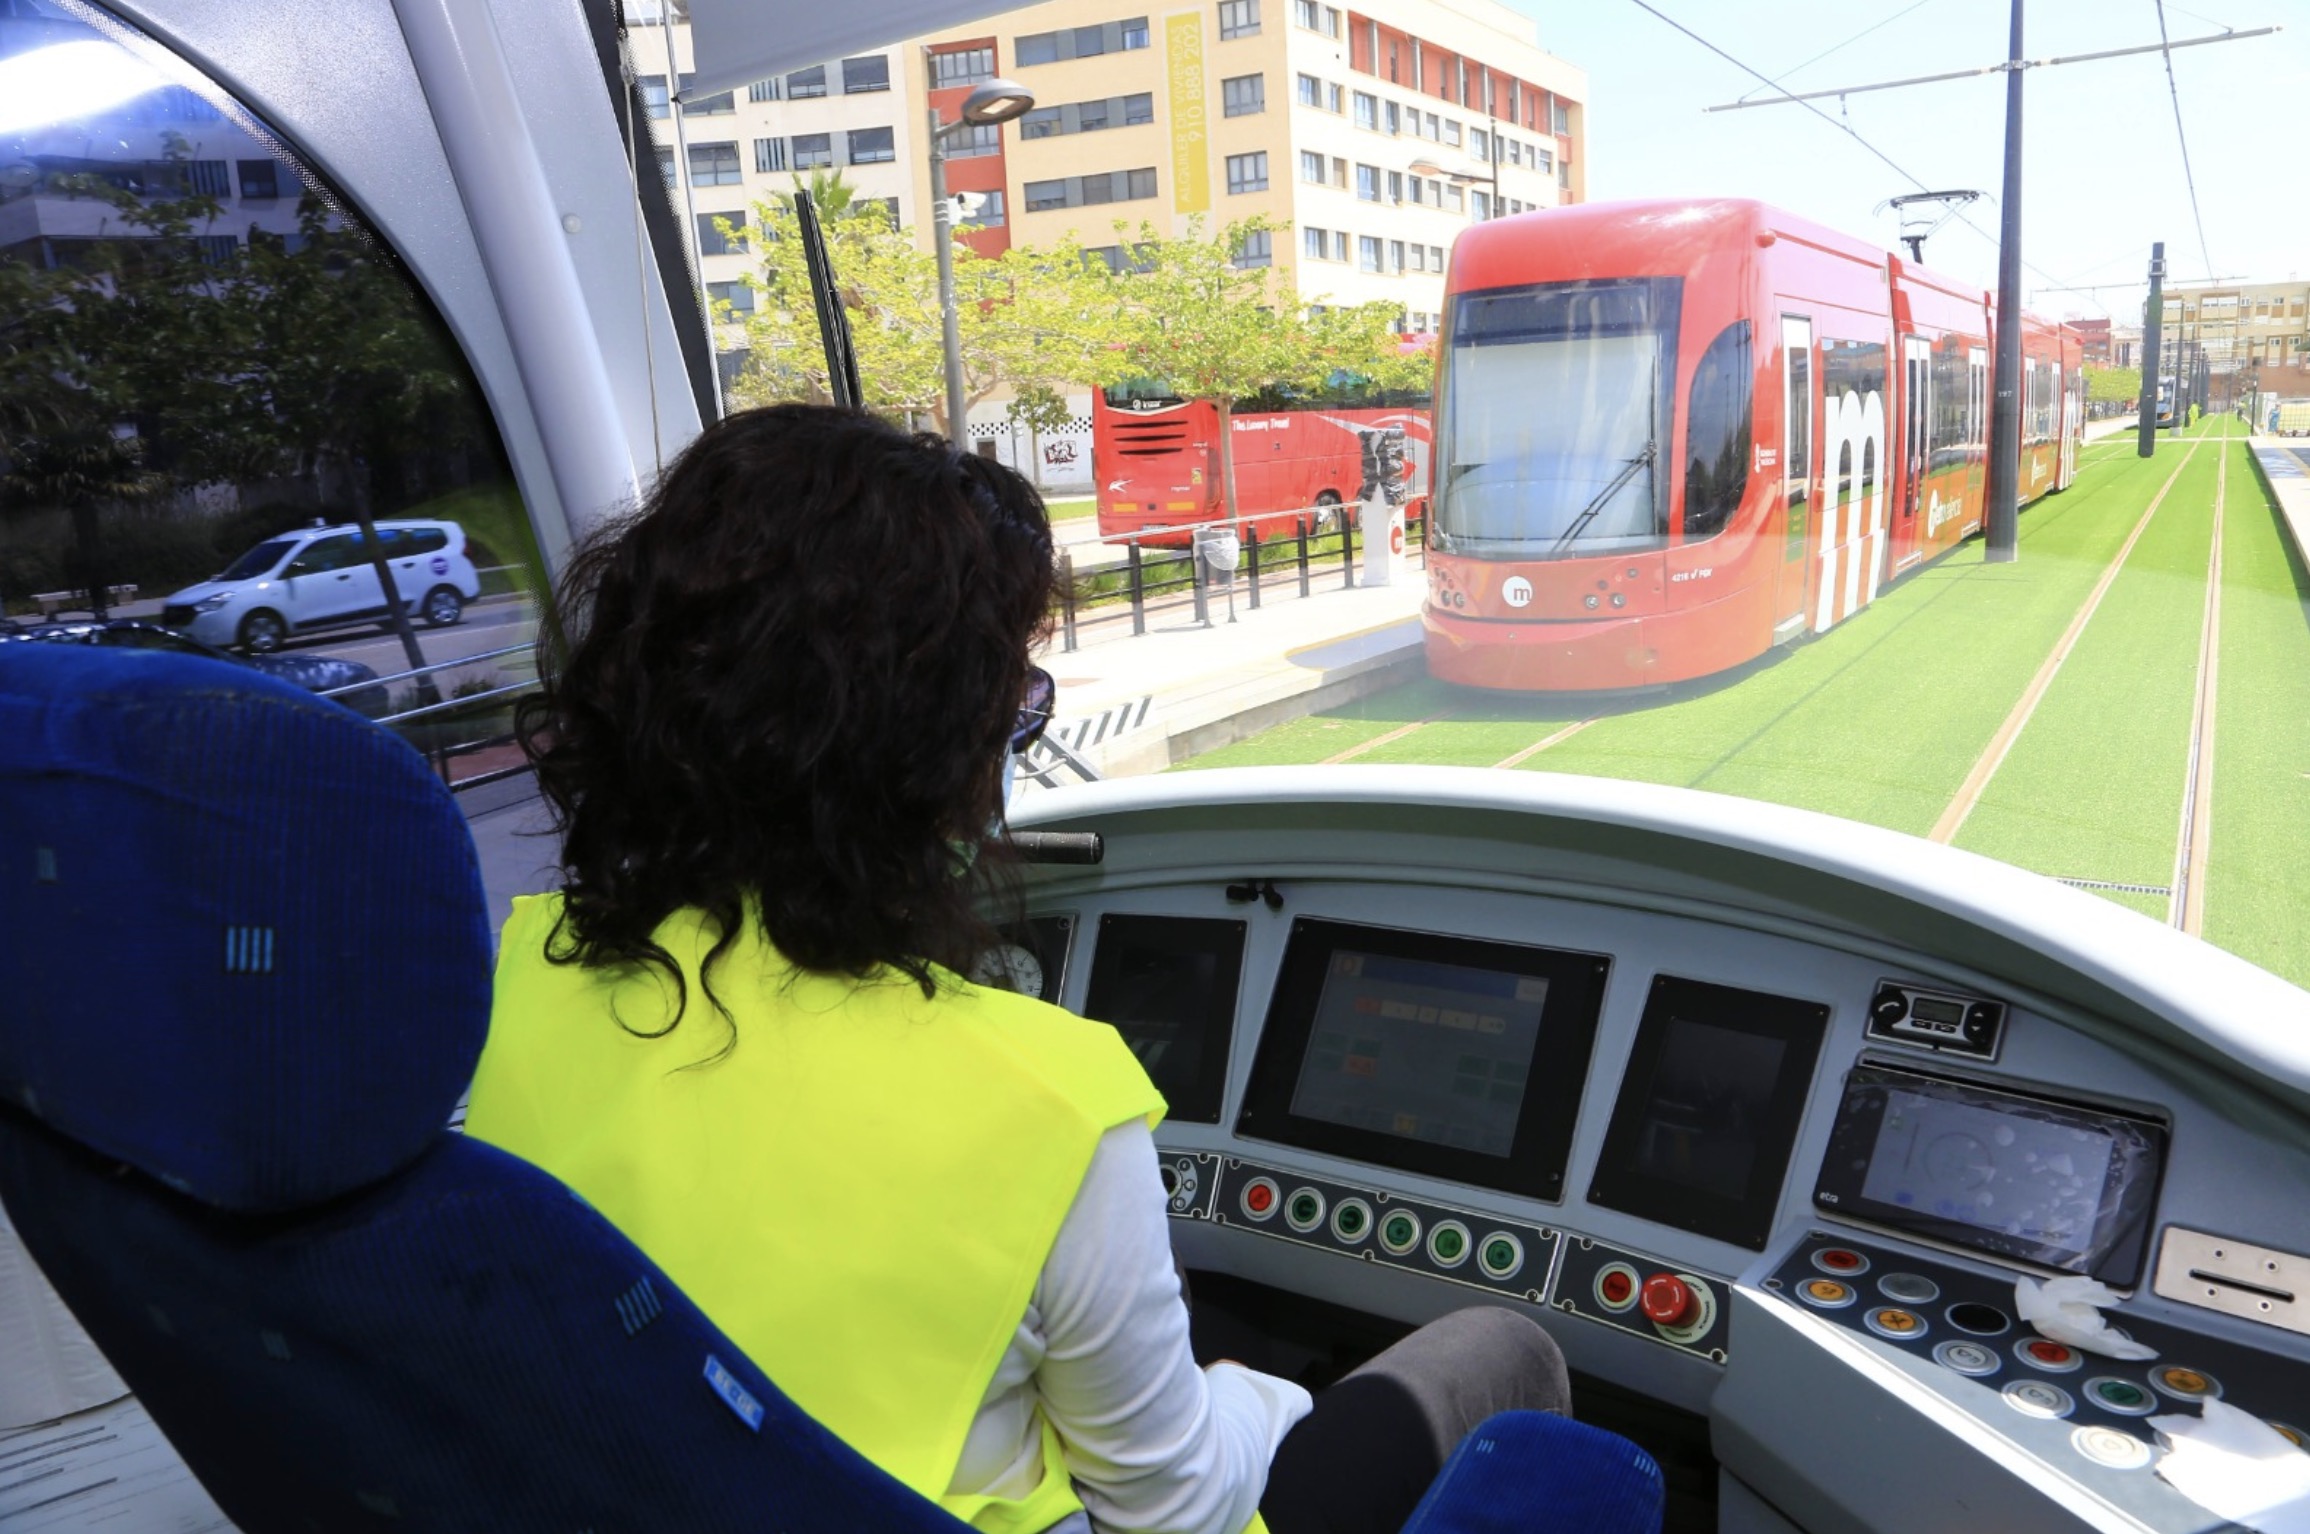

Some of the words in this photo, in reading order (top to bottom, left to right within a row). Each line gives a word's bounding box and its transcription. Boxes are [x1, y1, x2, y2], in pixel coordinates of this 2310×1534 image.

[1182, 22, 1200, 59] 202
[1170, 26, 1185, 104] VIVIENDAS
[1185, 64, 1201, 99] 888
[1175, 109, 1187, 129] DE
[1187, 106, 1203, 142] 910
[1176, 133, 1191, 202] ALQUILER
[1513, 587, 1531, 601] m
